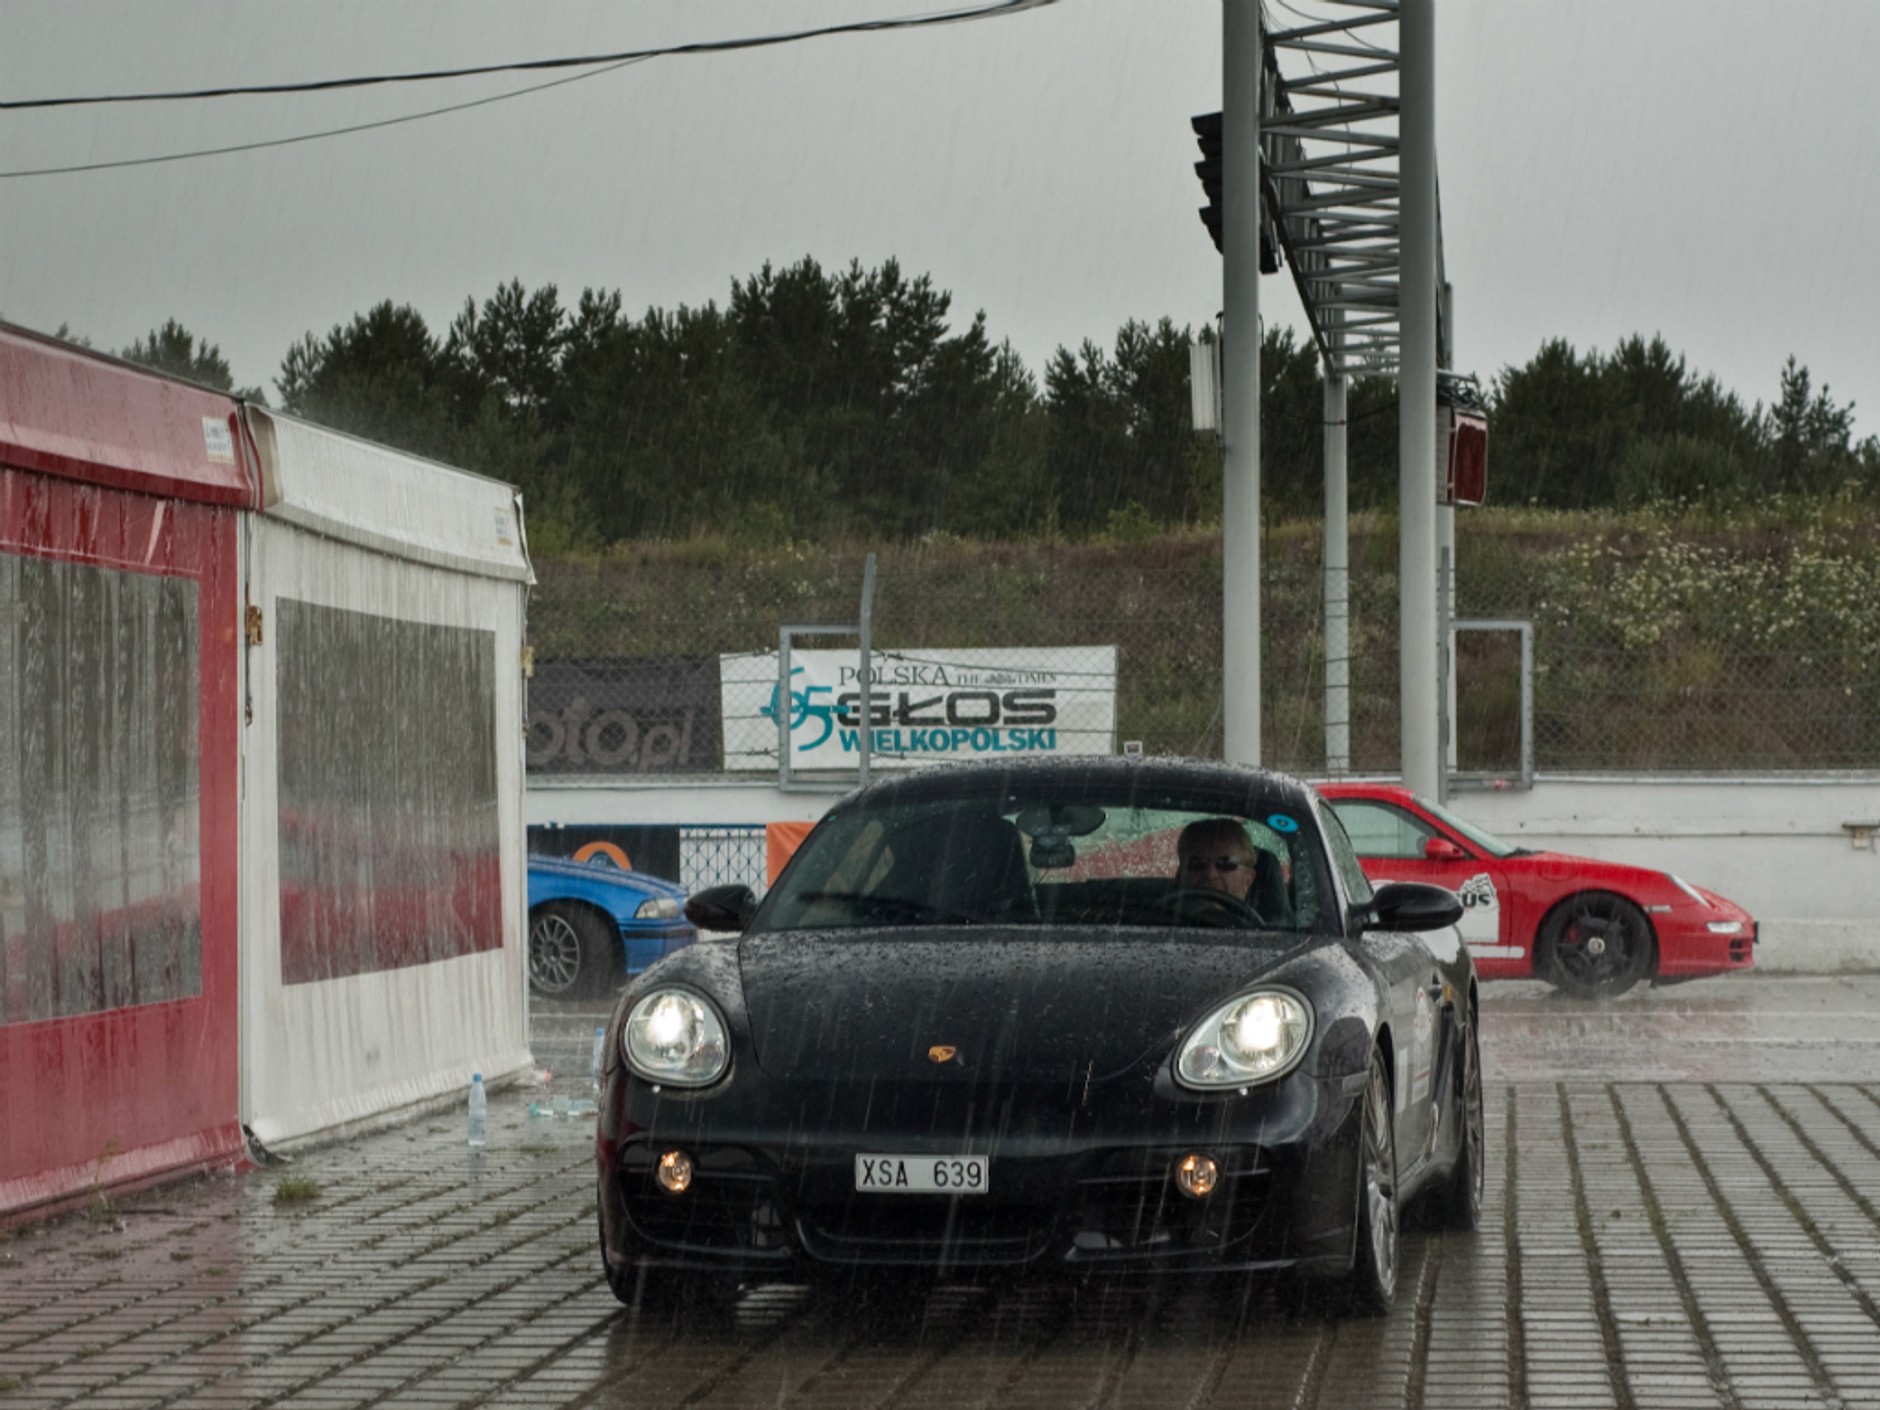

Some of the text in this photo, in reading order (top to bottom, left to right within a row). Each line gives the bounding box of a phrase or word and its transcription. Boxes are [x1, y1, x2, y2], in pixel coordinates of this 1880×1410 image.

[838, 665, 949, 686] POLSKA
[838, 728, 1057, 752] WIELKOPOLSKI
[862, 1159, 982, 1188] XSA 639
